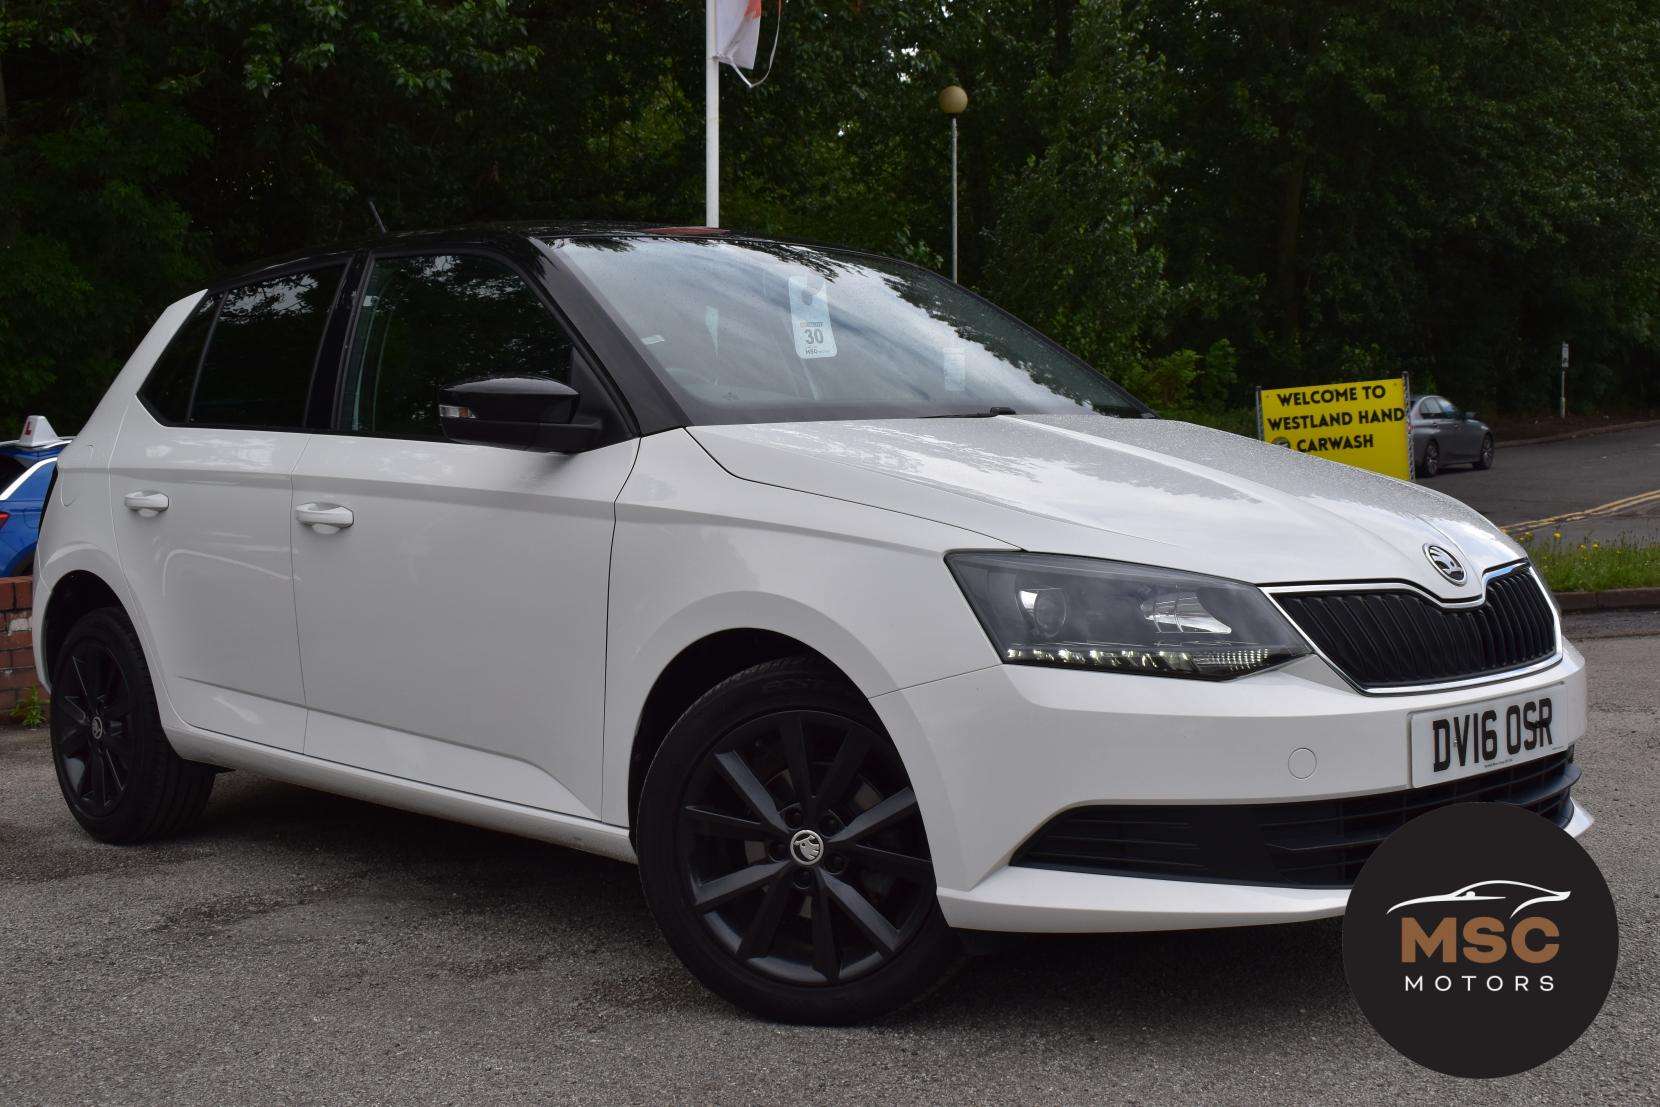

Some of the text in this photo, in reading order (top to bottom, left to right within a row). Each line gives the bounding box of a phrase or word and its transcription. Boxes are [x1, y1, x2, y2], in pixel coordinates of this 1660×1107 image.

[804, 328, 824, 345] 30
[1276, 385, 1386, 407] WELCOME TO
[1267, 407, 1405, 431] WESTLAND HAND
[1297, 434, 1374, 453] CARWASH
[1432, 697, 1553, 773] DV16 OSR
